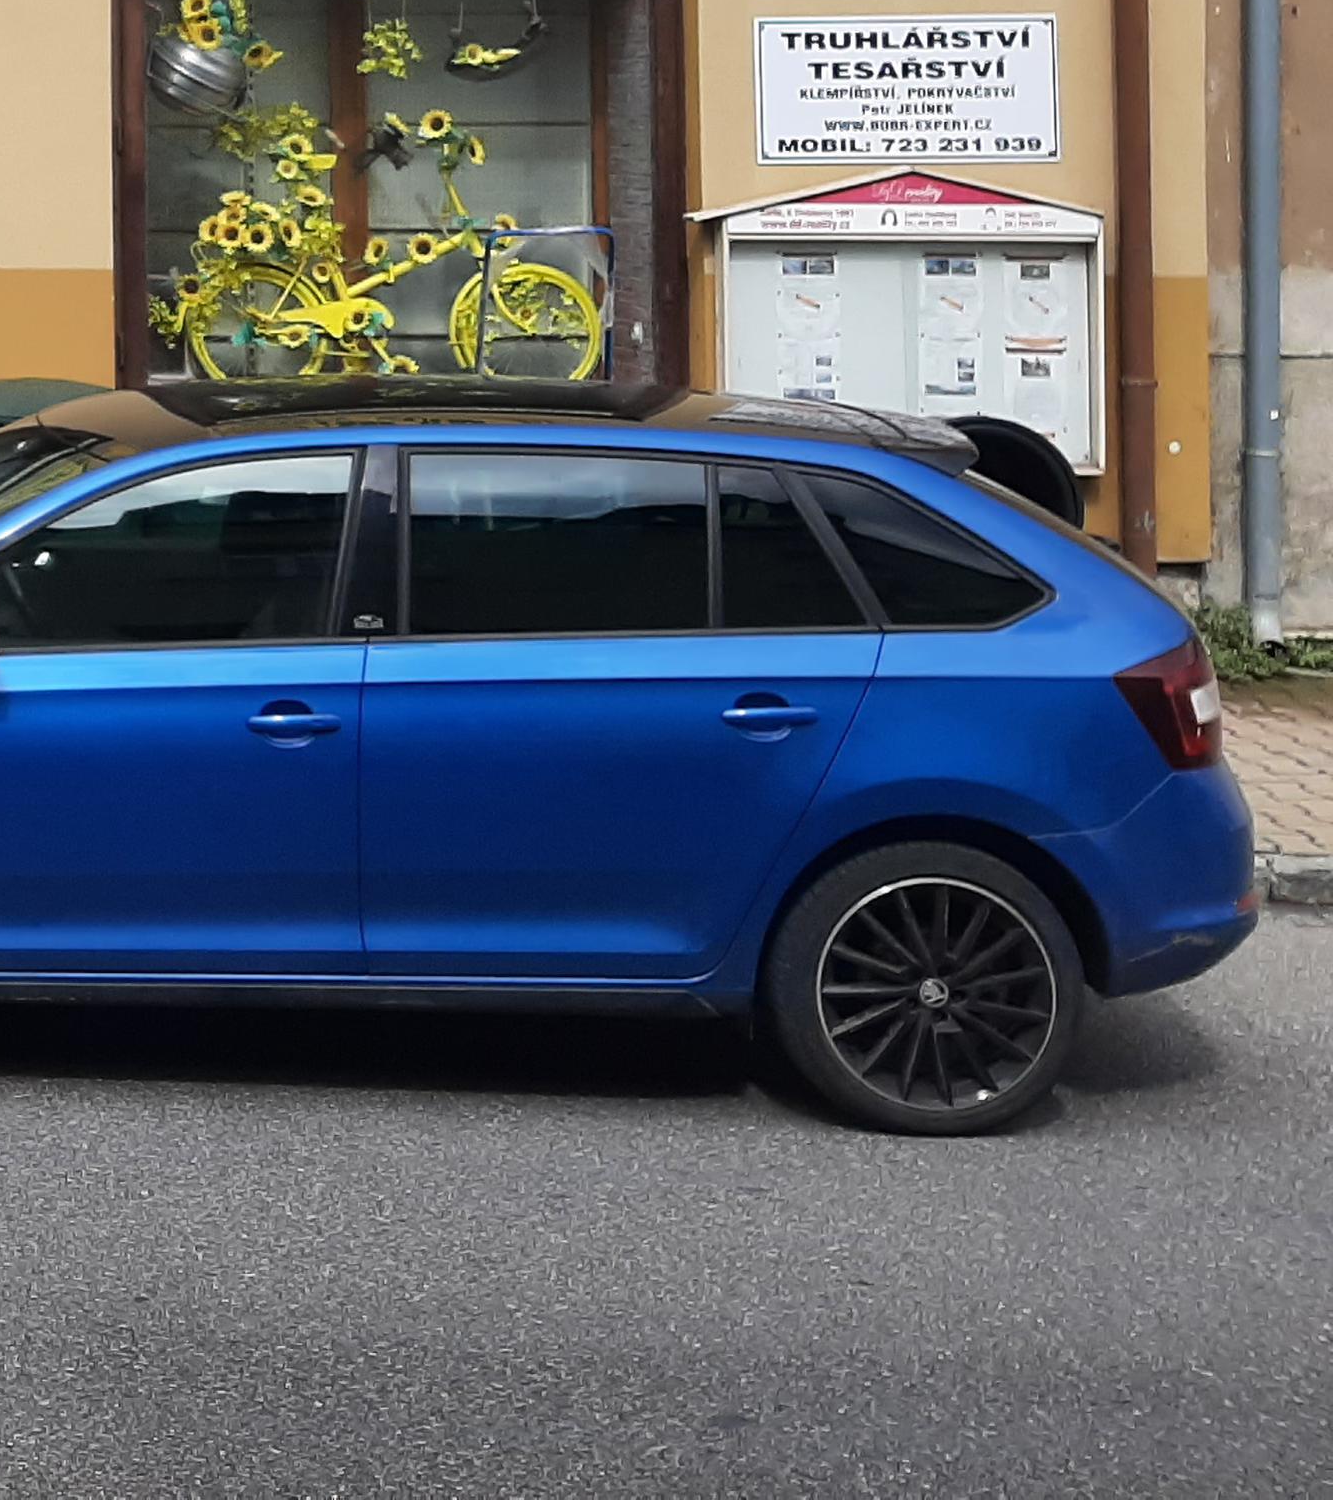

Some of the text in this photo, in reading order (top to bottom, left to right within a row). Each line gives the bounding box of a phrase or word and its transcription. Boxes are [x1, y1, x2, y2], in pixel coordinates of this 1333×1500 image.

[781, 25, 1031, 50] TRUHLÁŘSTVÍ
[807, 55, 1007, 80] TESAŘSTVÍ
[897, 102, 954, 115] JELÍNEK
[778, 138, 872, 153] MOBIL:
[882, 138, 929, 153] 723
[938, 138, 982, 152] 231
